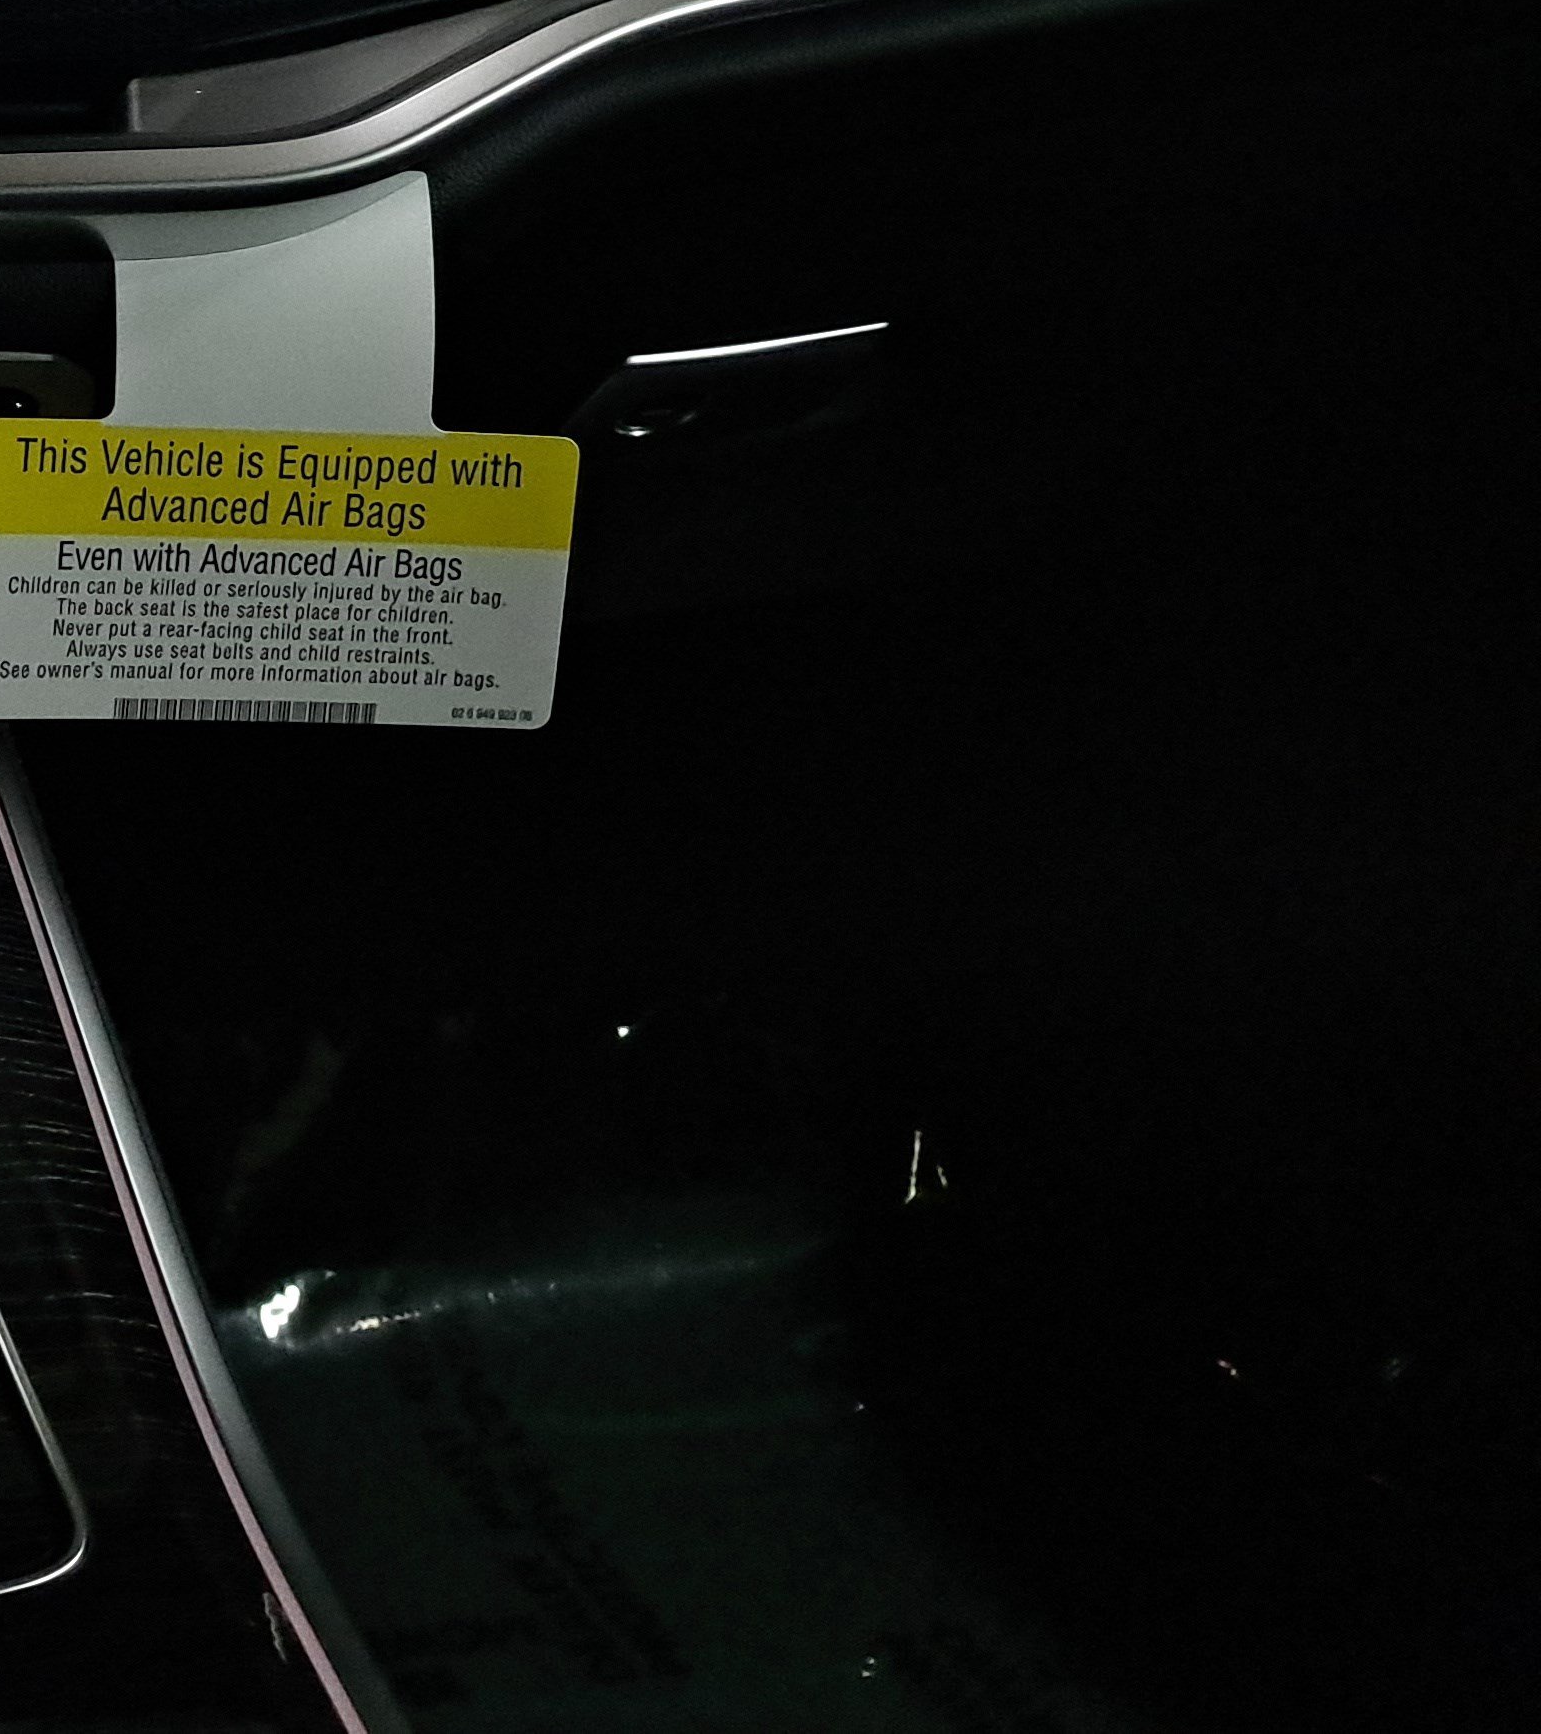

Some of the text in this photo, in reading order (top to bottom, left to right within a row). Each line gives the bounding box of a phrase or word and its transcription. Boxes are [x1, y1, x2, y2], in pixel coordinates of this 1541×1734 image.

[16, 436, 523, 491] This Vehicle is Equipped with
[100, 485, 426, 538] Advanced Air Bags
[57, 540, 463, 587] Even with Advanced Air Bags
[8, 575, 507, 610] Children can be killed or seriously injured by the air bag.
[55, 597, 455, 627] The back seat is the safest place for children.
[52, 617, 454, 646] Never put a rear-facing child seat in the front.
[65, 639, 436, 666] Always use seat belts and child restraints.
[36, 660, 104, 679] owner's
[109, 661, 174, 680] manual
[179, 661, 205, 681] for
[209, 666, 255, 683] more
[261, 663, 362, 685] information
[368, 666, 419, 686] about
[423, 668, 448, 687] air
[453, 669, 500, 692] bags.
